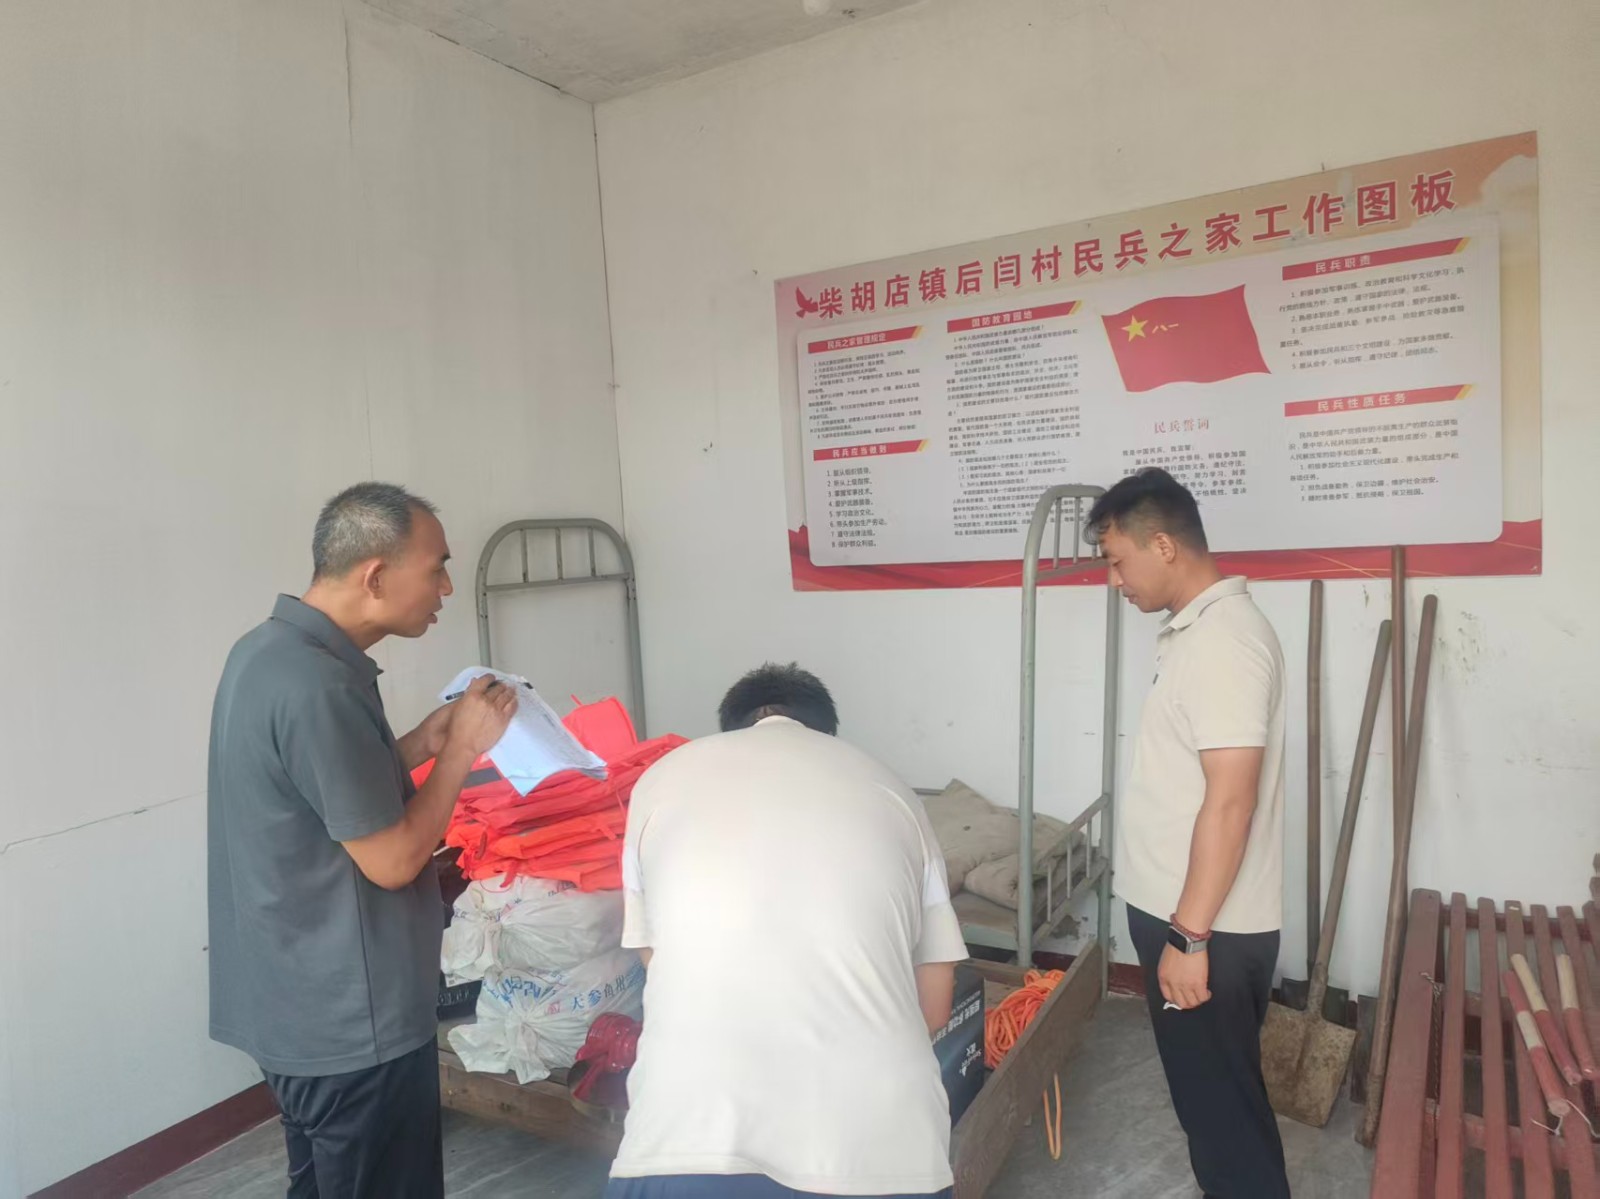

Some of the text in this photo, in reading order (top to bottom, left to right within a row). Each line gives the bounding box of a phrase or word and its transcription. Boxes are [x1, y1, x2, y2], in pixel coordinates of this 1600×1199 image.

[817, 169, 1457, 319] 柴胡店镇后闫村民兵之家工作图板
[1315, 255, 1371, 274] 民兵职责
[971, 310, 1033, 328] 国防教育园地
[827, 332, 887, 349] 民兵之家管理规定
[1317, 393, 1406, 412] 民兵性质任务
[1153, 418, 1210, 434] 民兵誓词
[832, 445, 888, 458] 民兵应当做到
